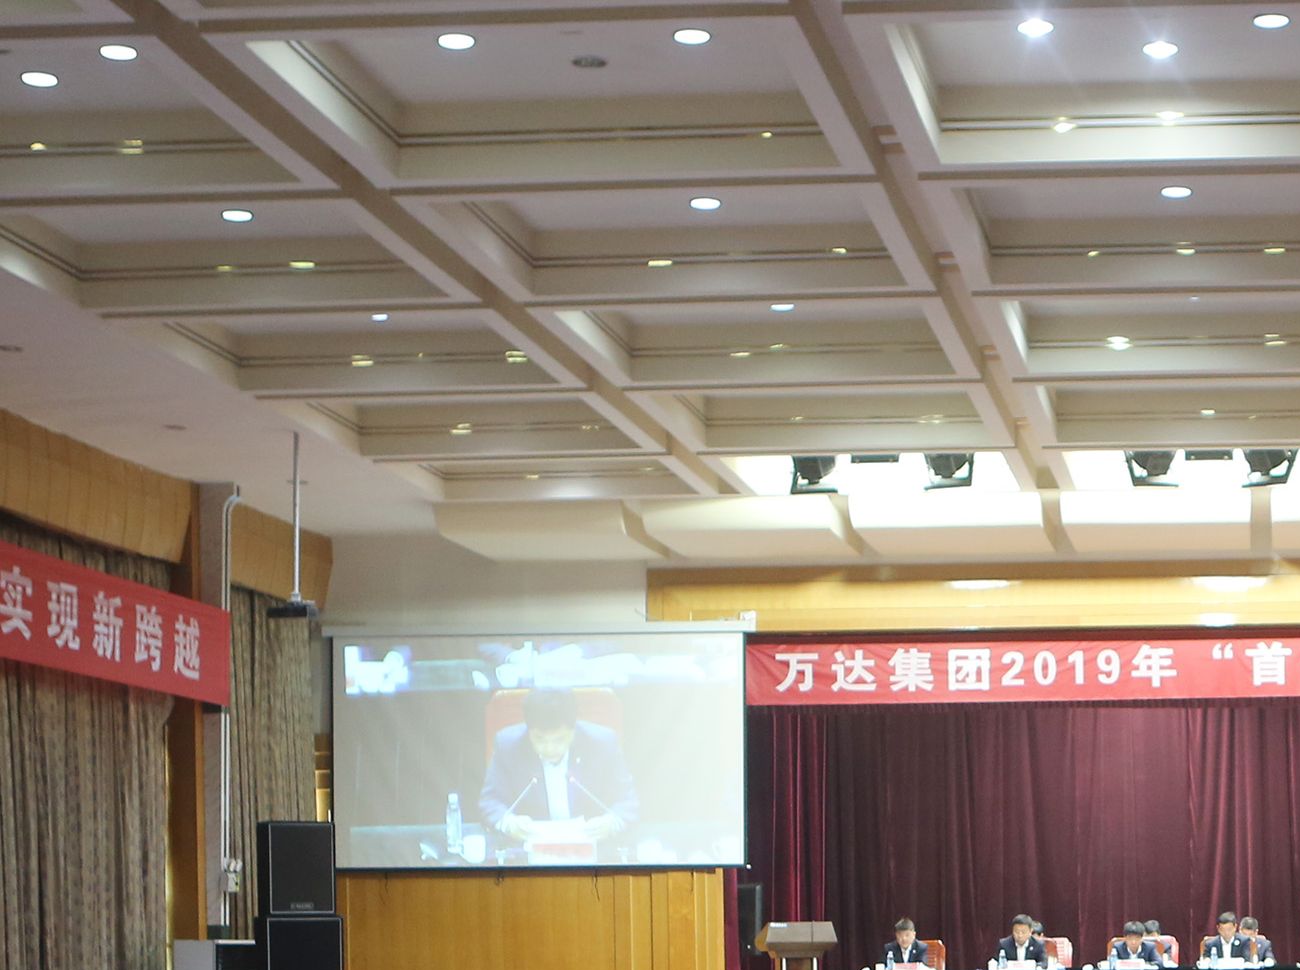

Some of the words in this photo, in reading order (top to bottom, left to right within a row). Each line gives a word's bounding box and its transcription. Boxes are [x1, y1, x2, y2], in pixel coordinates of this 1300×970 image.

[0, 566, 200, 680] 实现新跨越
[775, 644, 1178, 692] 万达集团2019年
